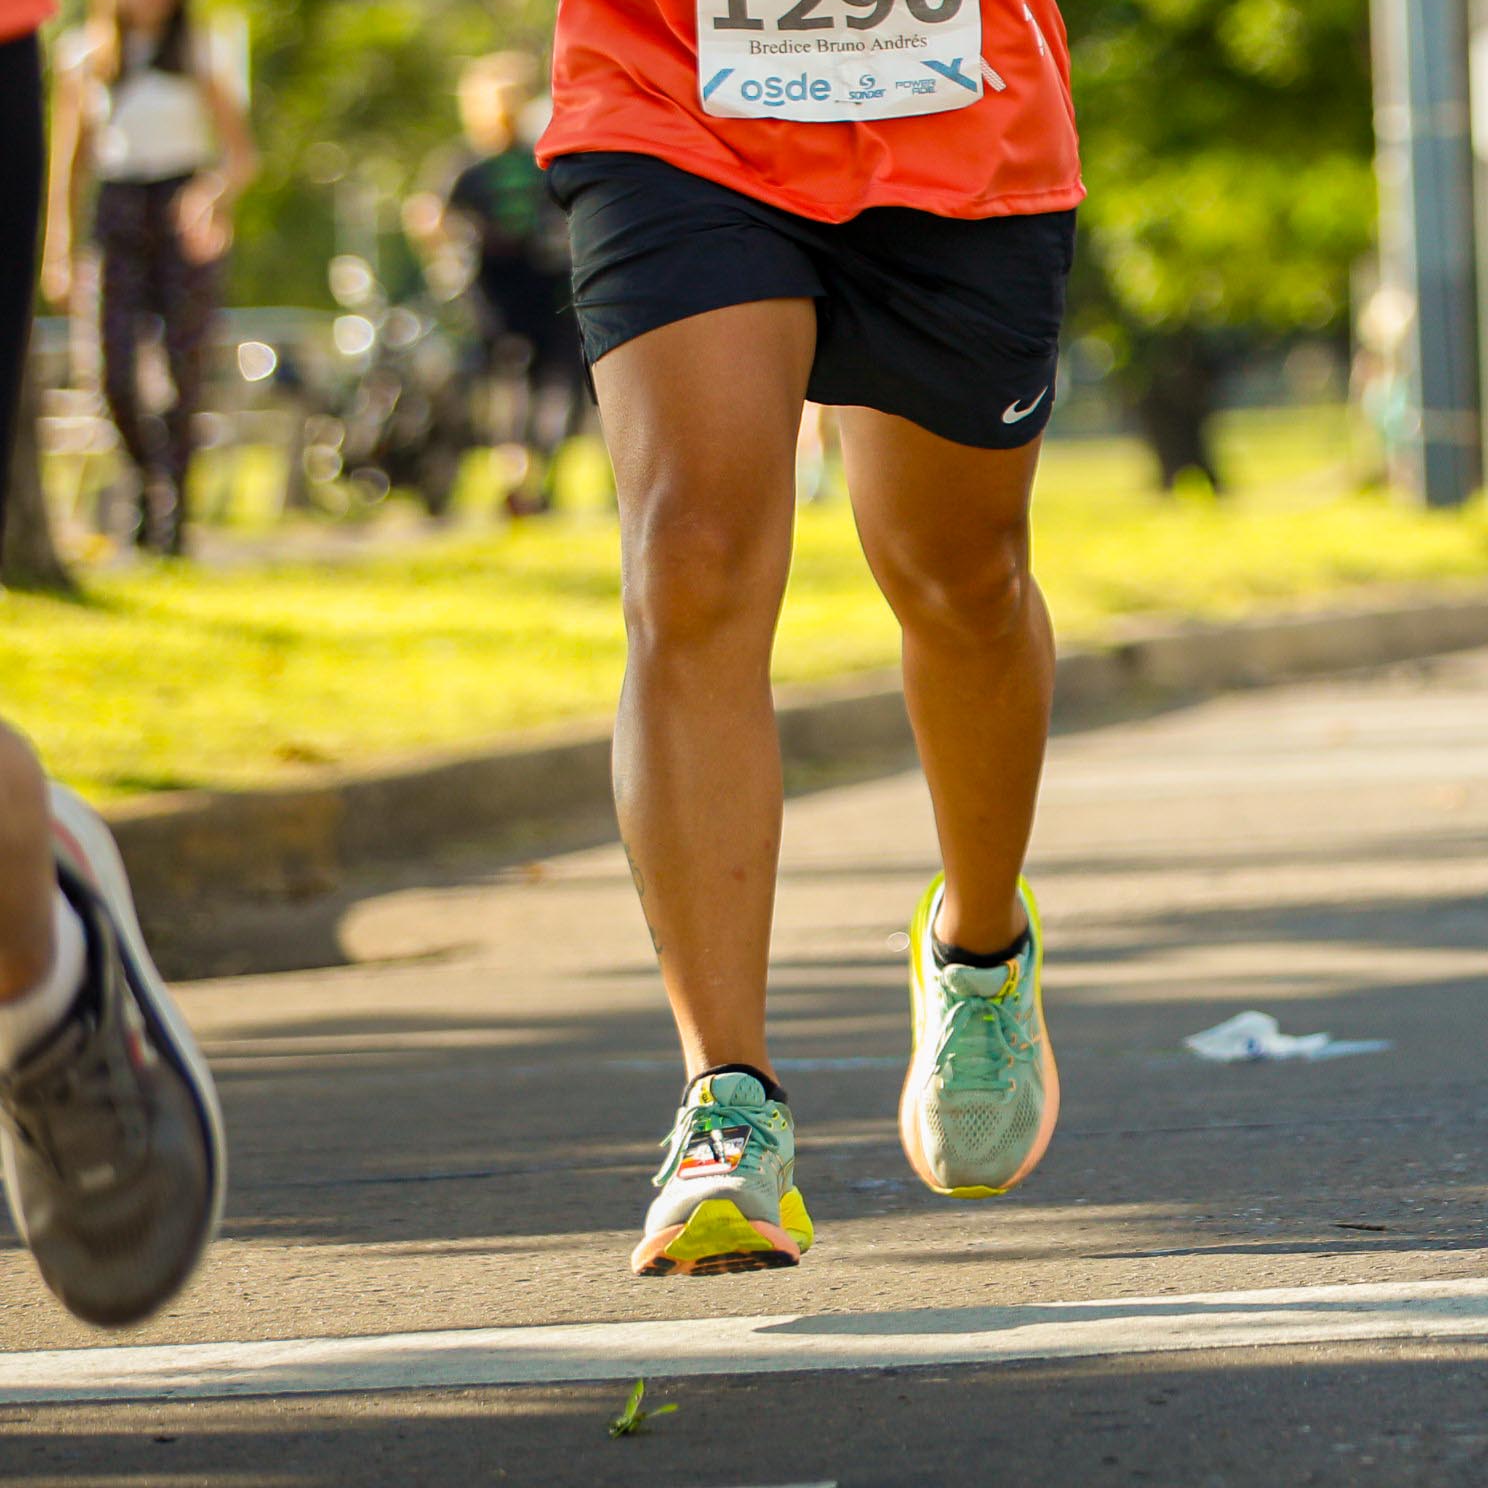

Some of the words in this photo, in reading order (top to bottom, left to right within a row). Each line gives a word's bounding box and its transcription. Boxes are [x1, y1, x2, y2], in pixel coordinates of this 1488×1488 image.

[749, 39, 811, 55] Bredice
[816, 39, 866, 53] Bruno
[870, 33, 928, 51] Andrés
[740, 72, 832, 101] osde
[895, 78, 936, 89] POWER
